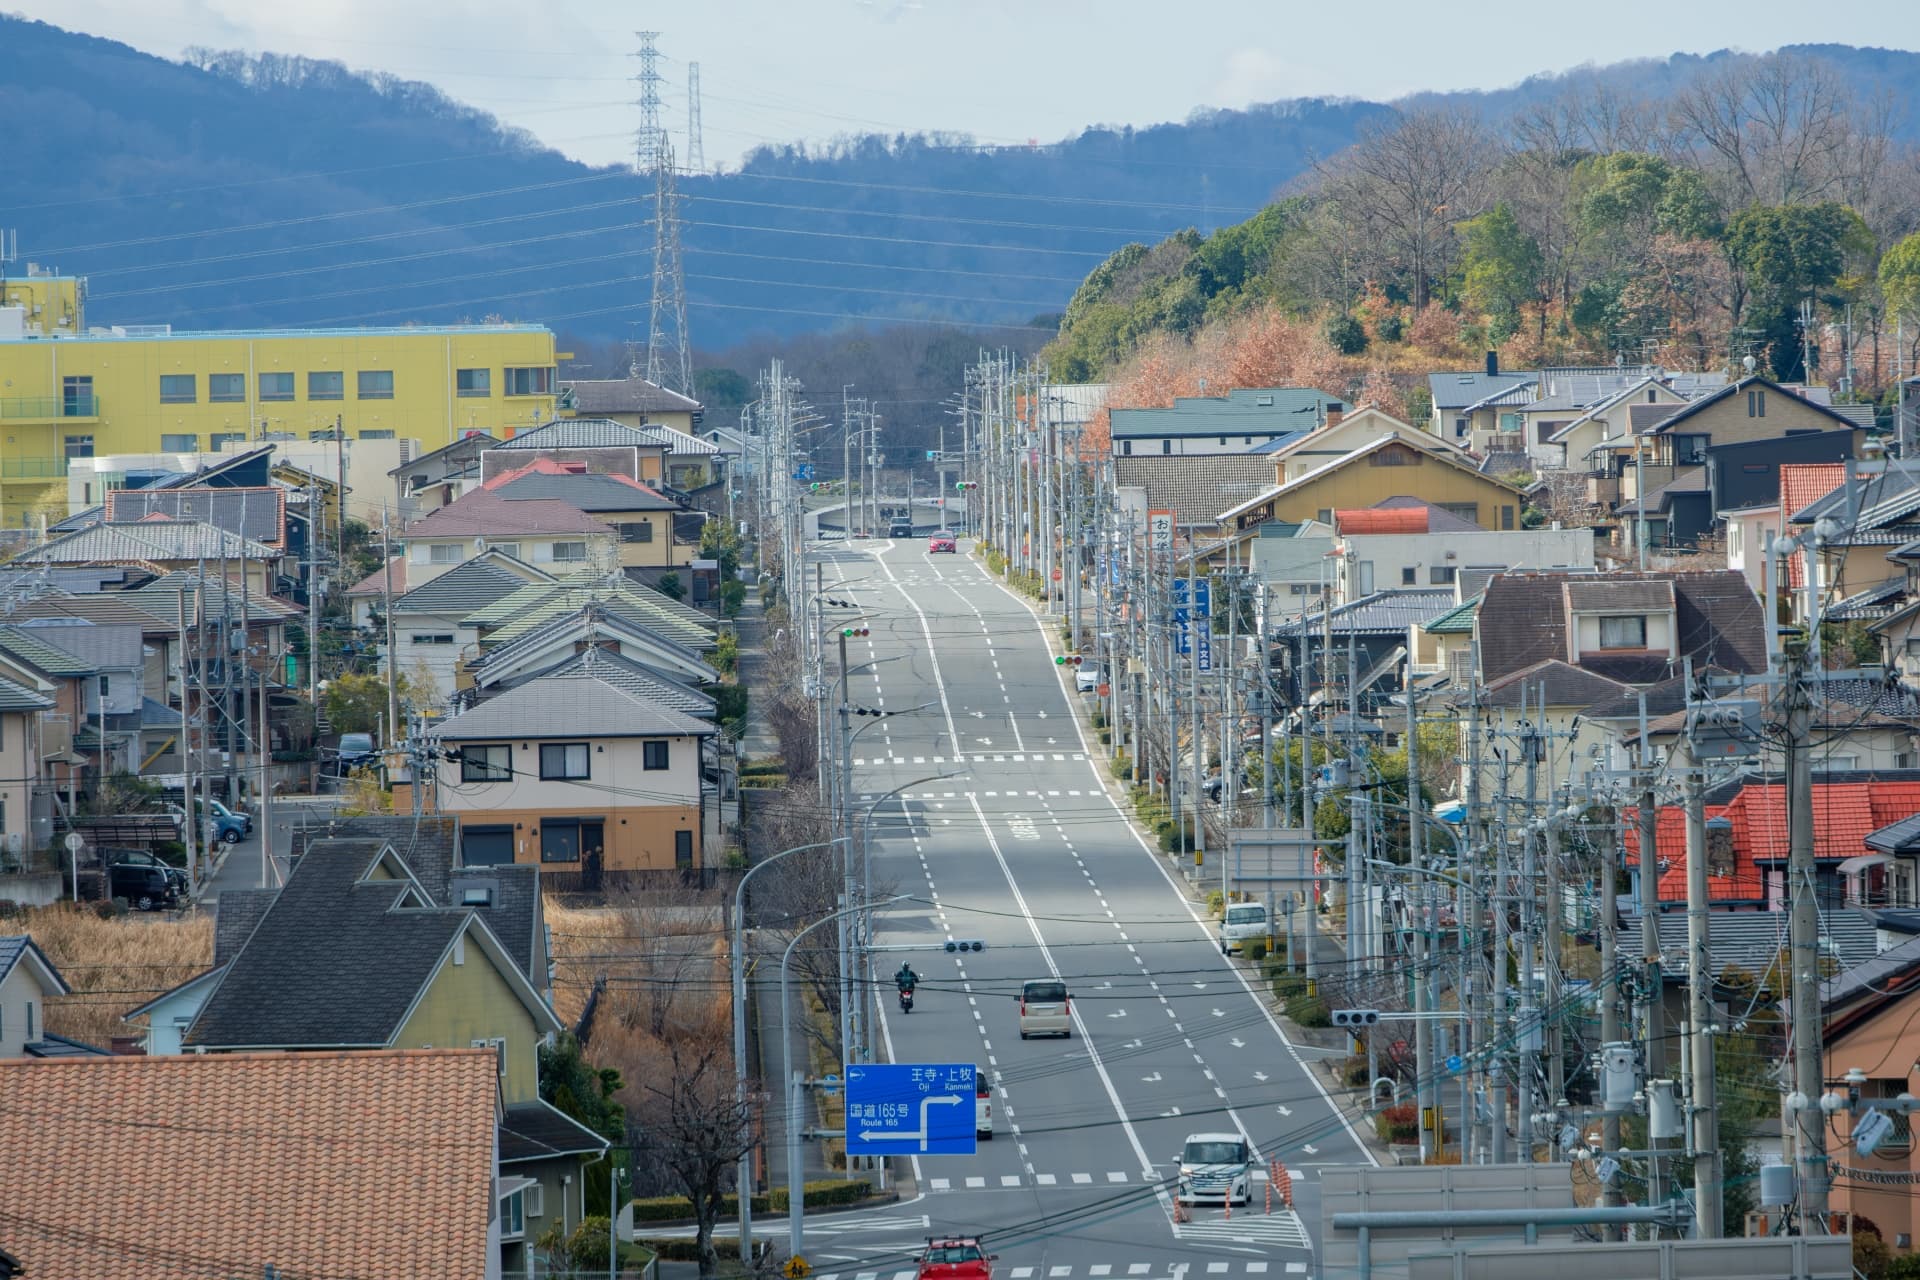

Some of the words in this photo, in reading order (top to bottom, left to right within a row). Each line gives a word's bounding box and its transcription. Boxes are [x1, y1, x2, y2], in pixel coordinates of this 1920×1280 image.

[911, 1068, 972, 1082] 王寺・上牧
[919, 1083, 930, 1092] Oji
[945, 1083, 973, 1091] Kanmaki
[850, 1103, 909, 1118] 国道165号
[861, 1118, 882, 1127] Route
[885, 1118, 898, 1127] 165
